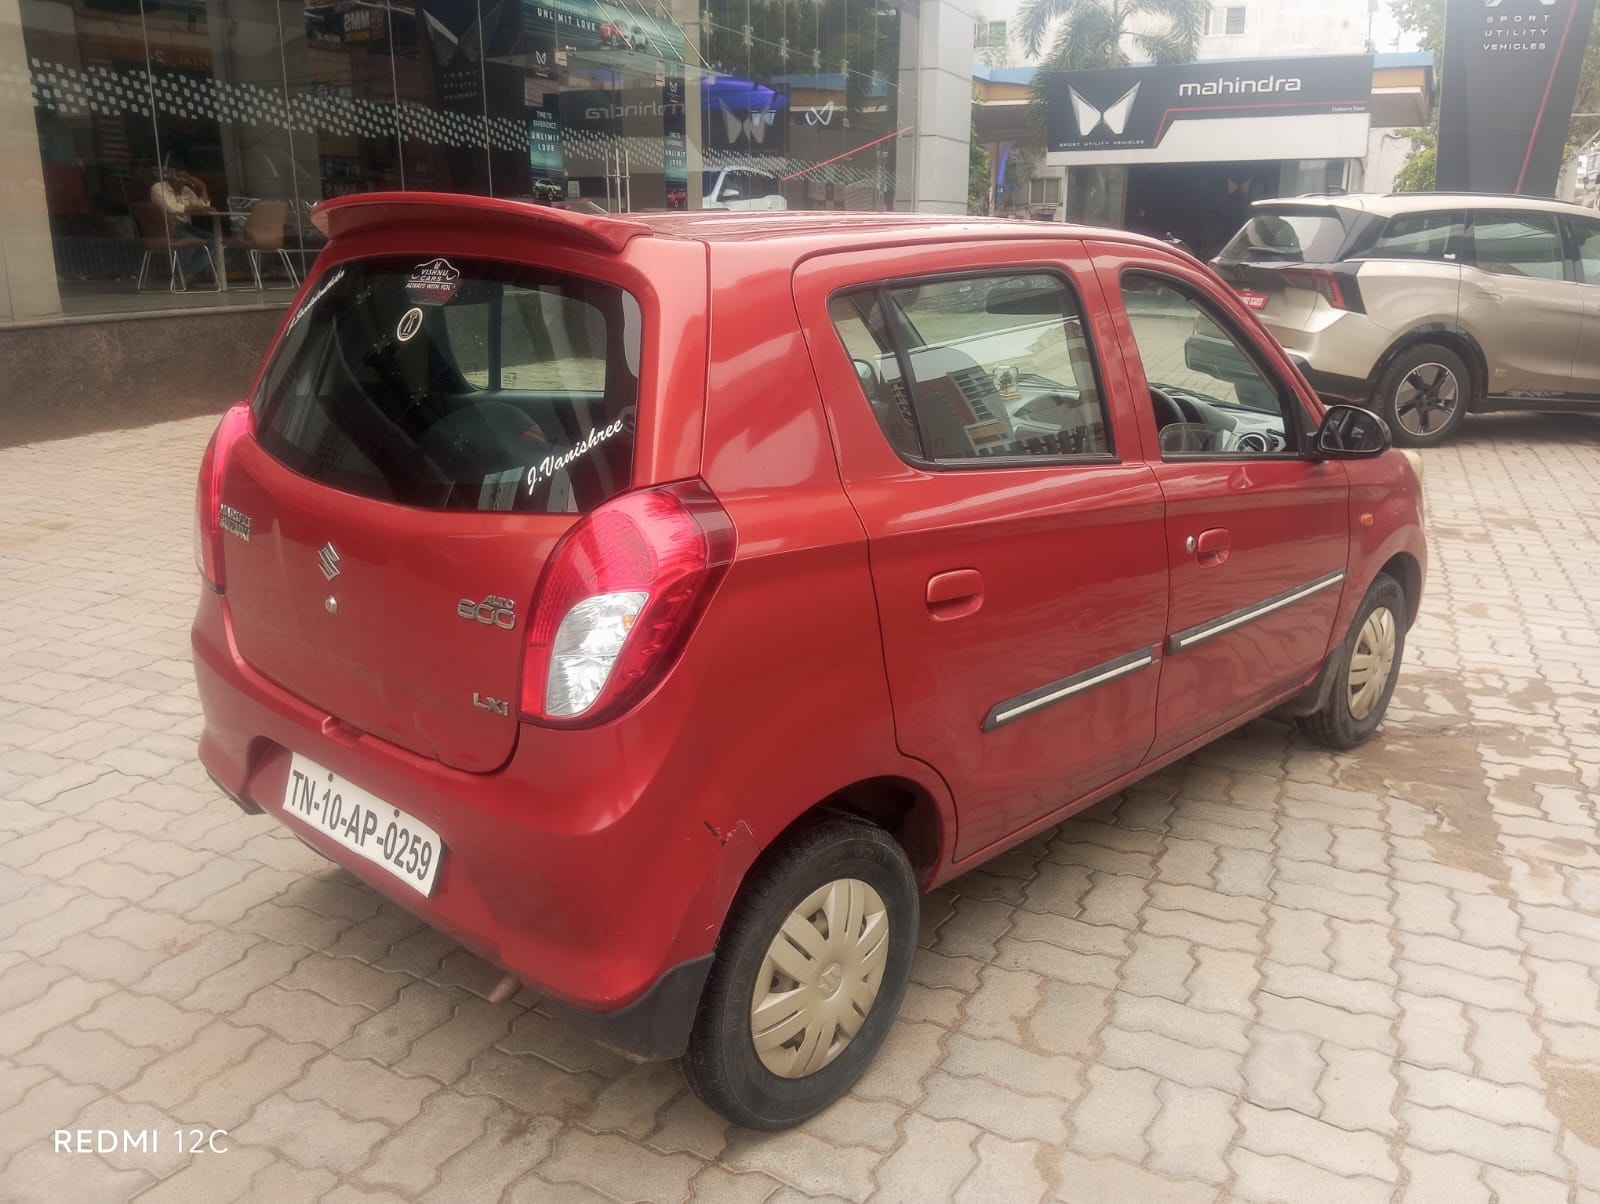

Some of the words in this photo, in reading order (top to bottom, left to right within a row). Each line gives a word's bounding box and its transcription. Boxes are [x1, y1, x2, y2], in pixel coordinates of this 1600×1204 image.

[537, 8, 572, 25] UNLIMIT
[576, 18, 596, 32] LOVE
[1486, 14, 1551, 23] SPORT
[1484, 28, 1549, 37] UTILITY
[1483, 42, 1546, 50] VEHICLES
[1178, 75, 1302, 97] mahindra
[531, 131, 559, 142] UNLIMIT
[538, 143, 555, 152] LOVE
[421, 268, 449, 277] VISHNU
[457, 598, 516, 630] 800
[291, 769, 432, 881] TN-10-AP-0259
